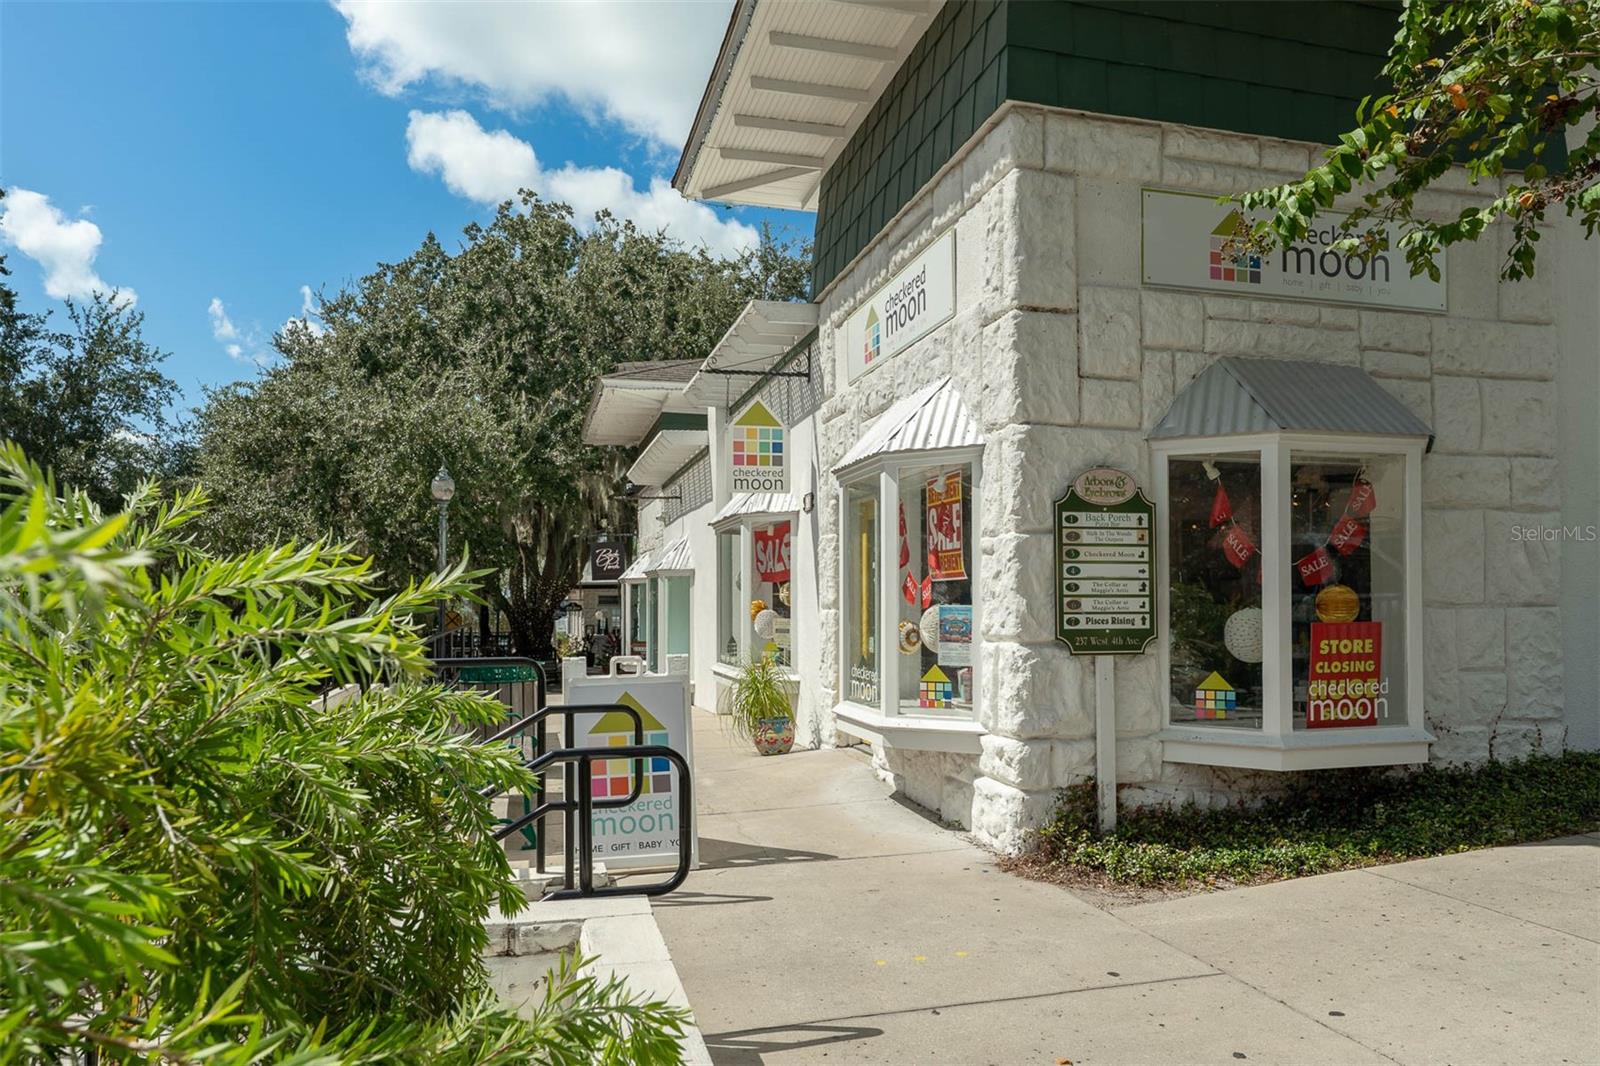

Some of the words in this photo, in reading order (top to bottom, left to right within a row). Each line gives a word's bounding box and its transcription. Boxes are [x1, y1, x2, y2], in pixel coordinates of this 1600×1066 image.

[1282, 246, 1389, 282] moon
[885, 264, 926, 313] checkered
[886, 287, 927, 338] moon
[733, 468, 784, 478] checkered
[734, 478, 784, 491] moon
[1085, 513, 1105, 521] Back
[1108, 514, 1132, 522] Porch
[1335, 521, 1358, 549] SALE
[1227, 533, 1249, 561] SALE
[1301, 556, 1329, 577] SALE
[1085, 617, 1109, 625] Pisces
[1111, 617, 1135, 626] Rising
[1090, 637, 1108, 646] West
[1112, 636, 1122, 646] 4th
[1320, 639, 1373, 655] STORE
[1315, 660, 1376, 674] CLOSING
[851, 680, 878, 702] moon
[1309, 677, 1389, 697] checkered
[1310, 698, 1389, 721] moon
[592, 813, 674, 837] moon
[574, 844, 604, 854] HME
[611, 842, 631, 852] GIFT
[639, 840, 663, 849] BABY
